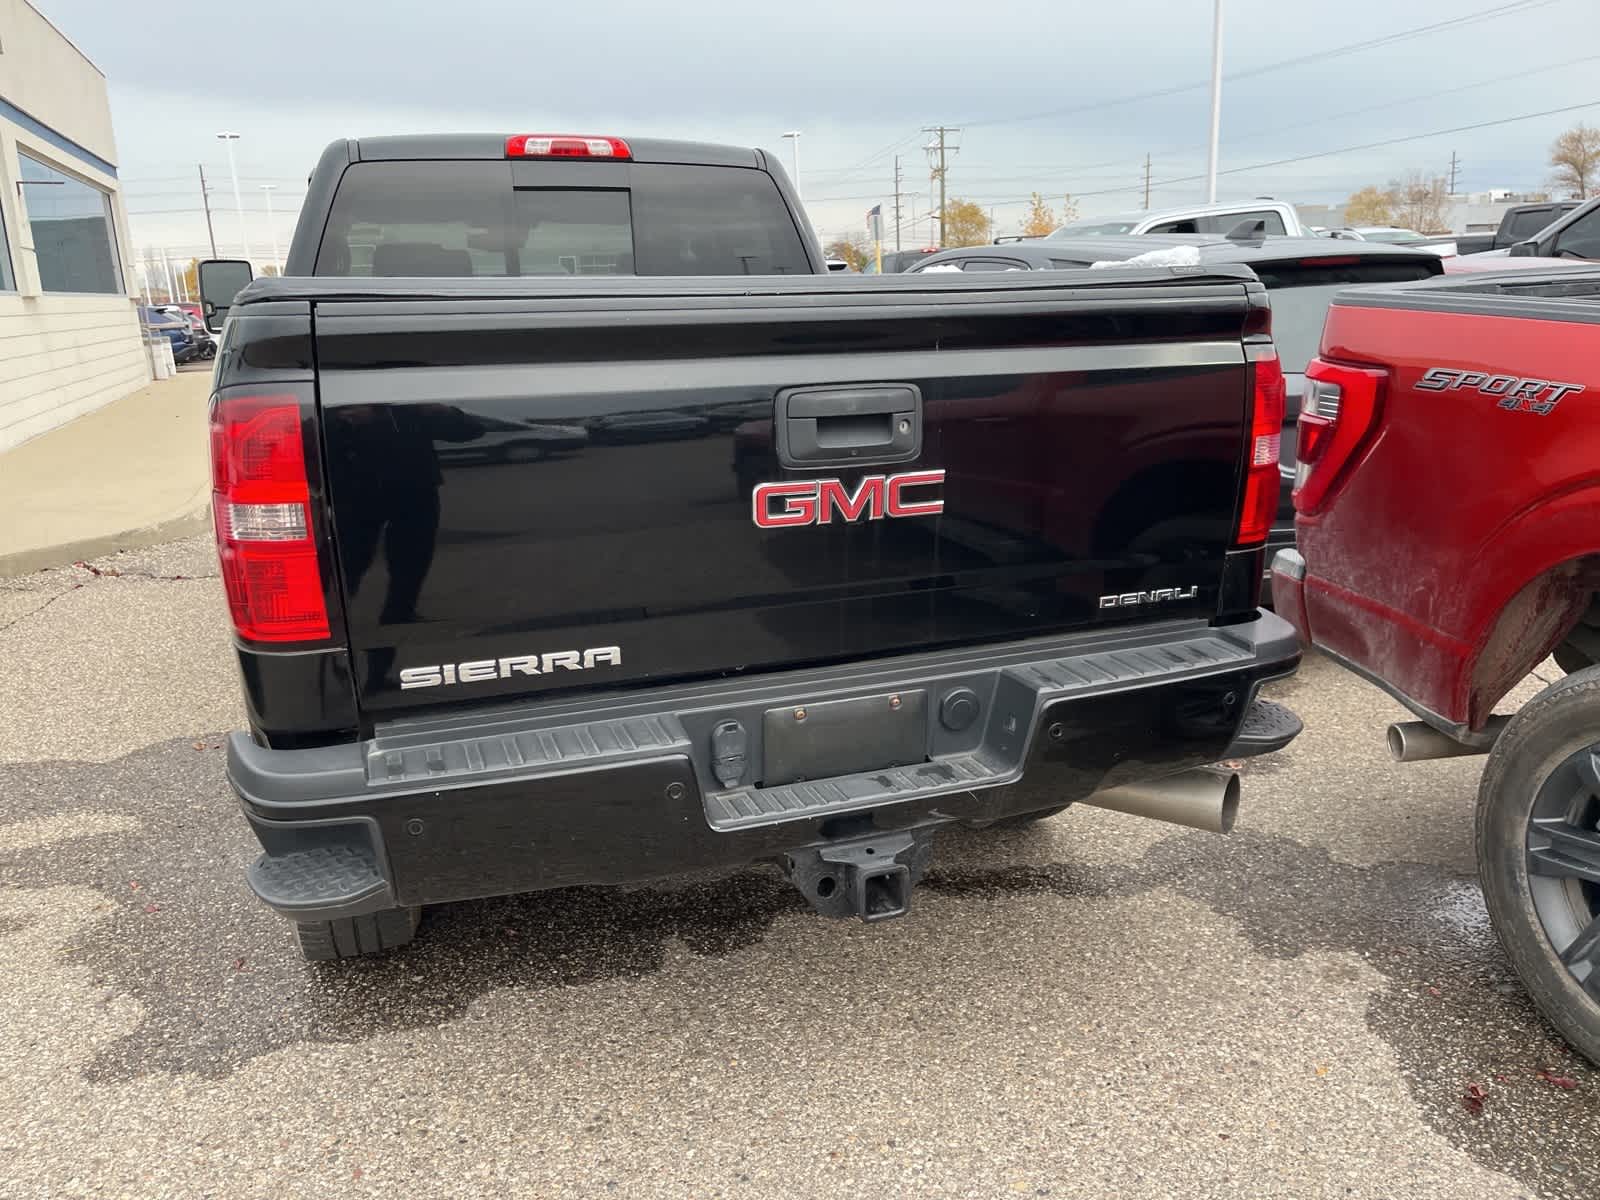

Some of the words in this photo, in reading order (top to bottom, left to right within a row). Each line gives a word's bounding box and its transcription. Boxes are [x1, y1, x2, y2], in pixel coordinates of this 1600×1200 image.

[1413, 367, 1586, 403] SPORT
[752, 469, 946, 528] GMC
[1099, 585, 1198, 608] DENALI
[399, 646, 622, 690] SIERRA
